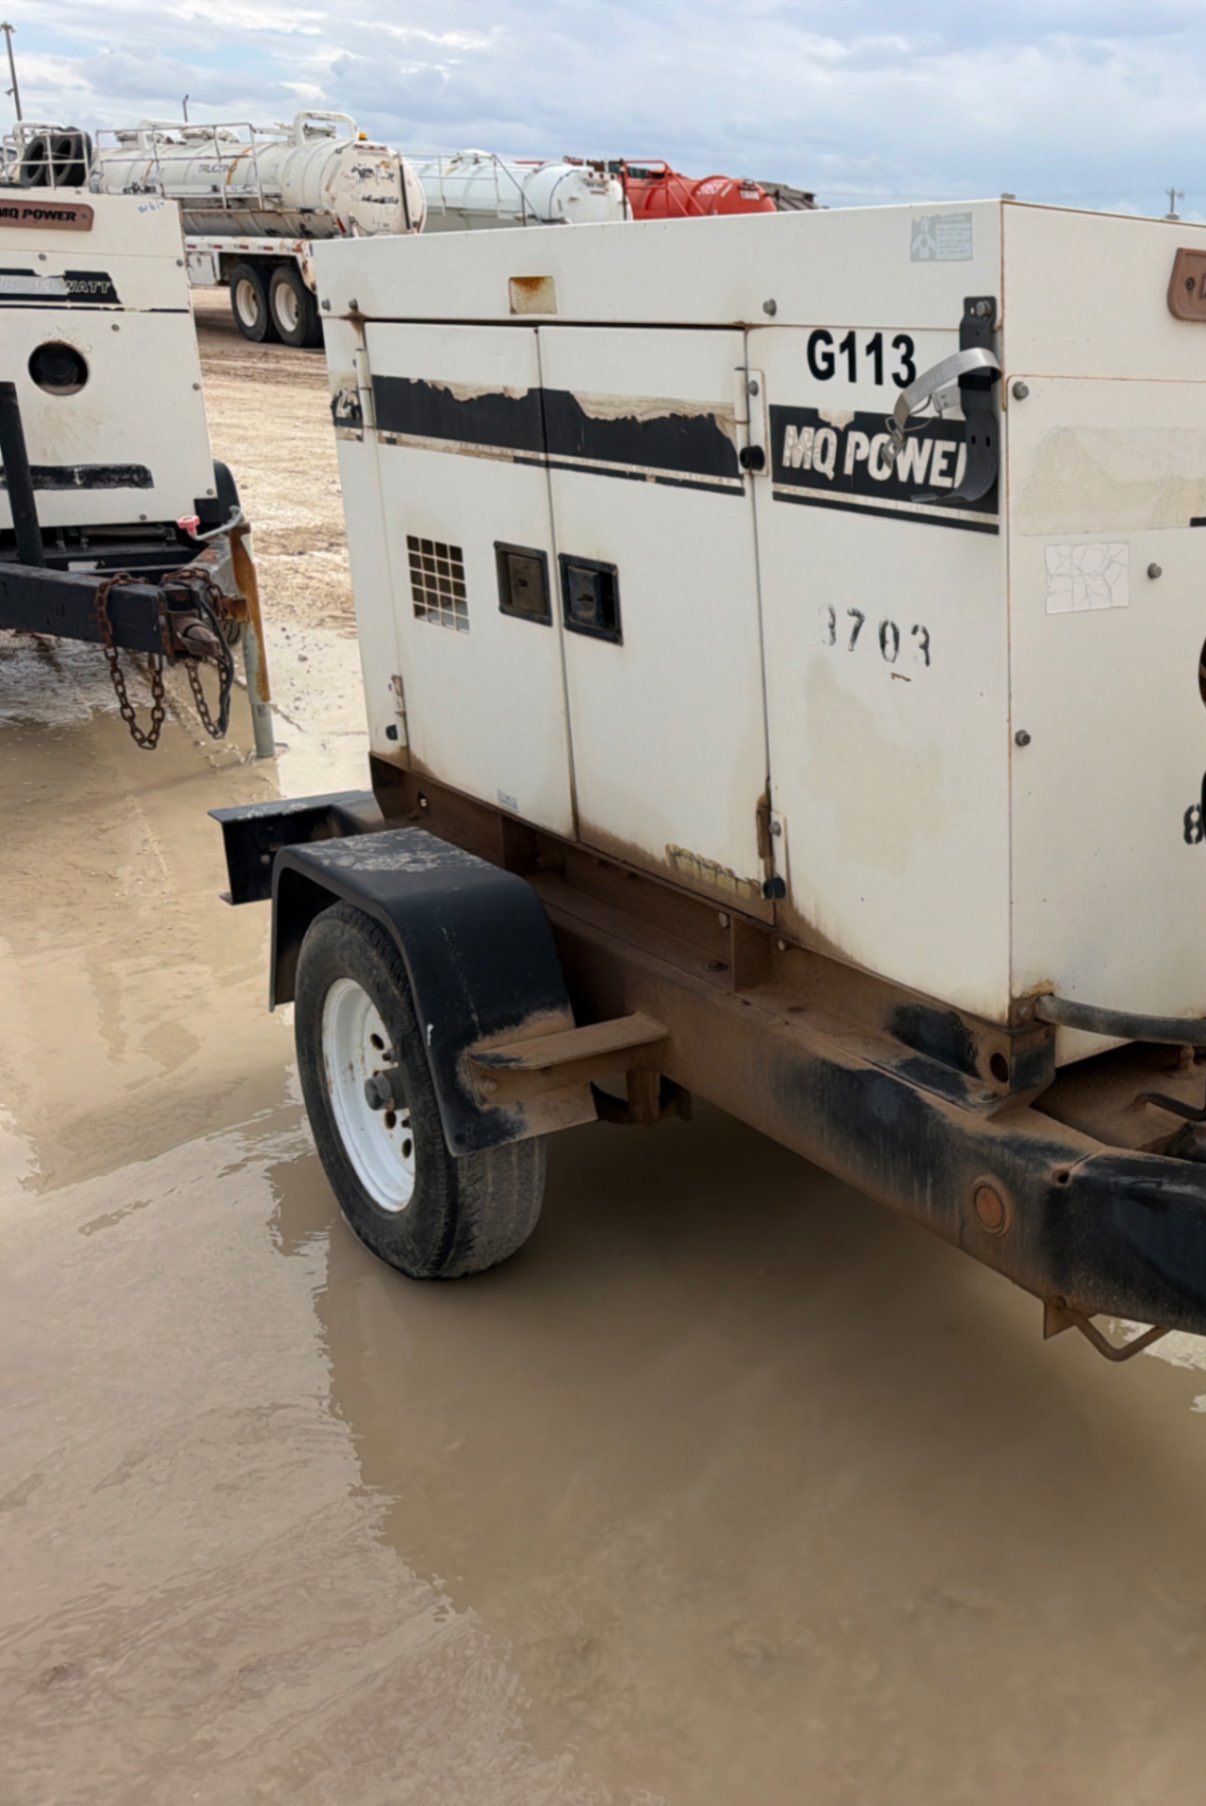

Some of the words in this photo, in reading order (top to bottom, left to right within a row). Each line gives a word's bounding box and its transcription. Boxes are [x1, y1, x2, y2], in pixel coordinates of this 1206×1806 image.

[22, 208, 77, 222] POWER
[807, 329, 917, 389] G113
[782, 424, 838, 480] MQ
